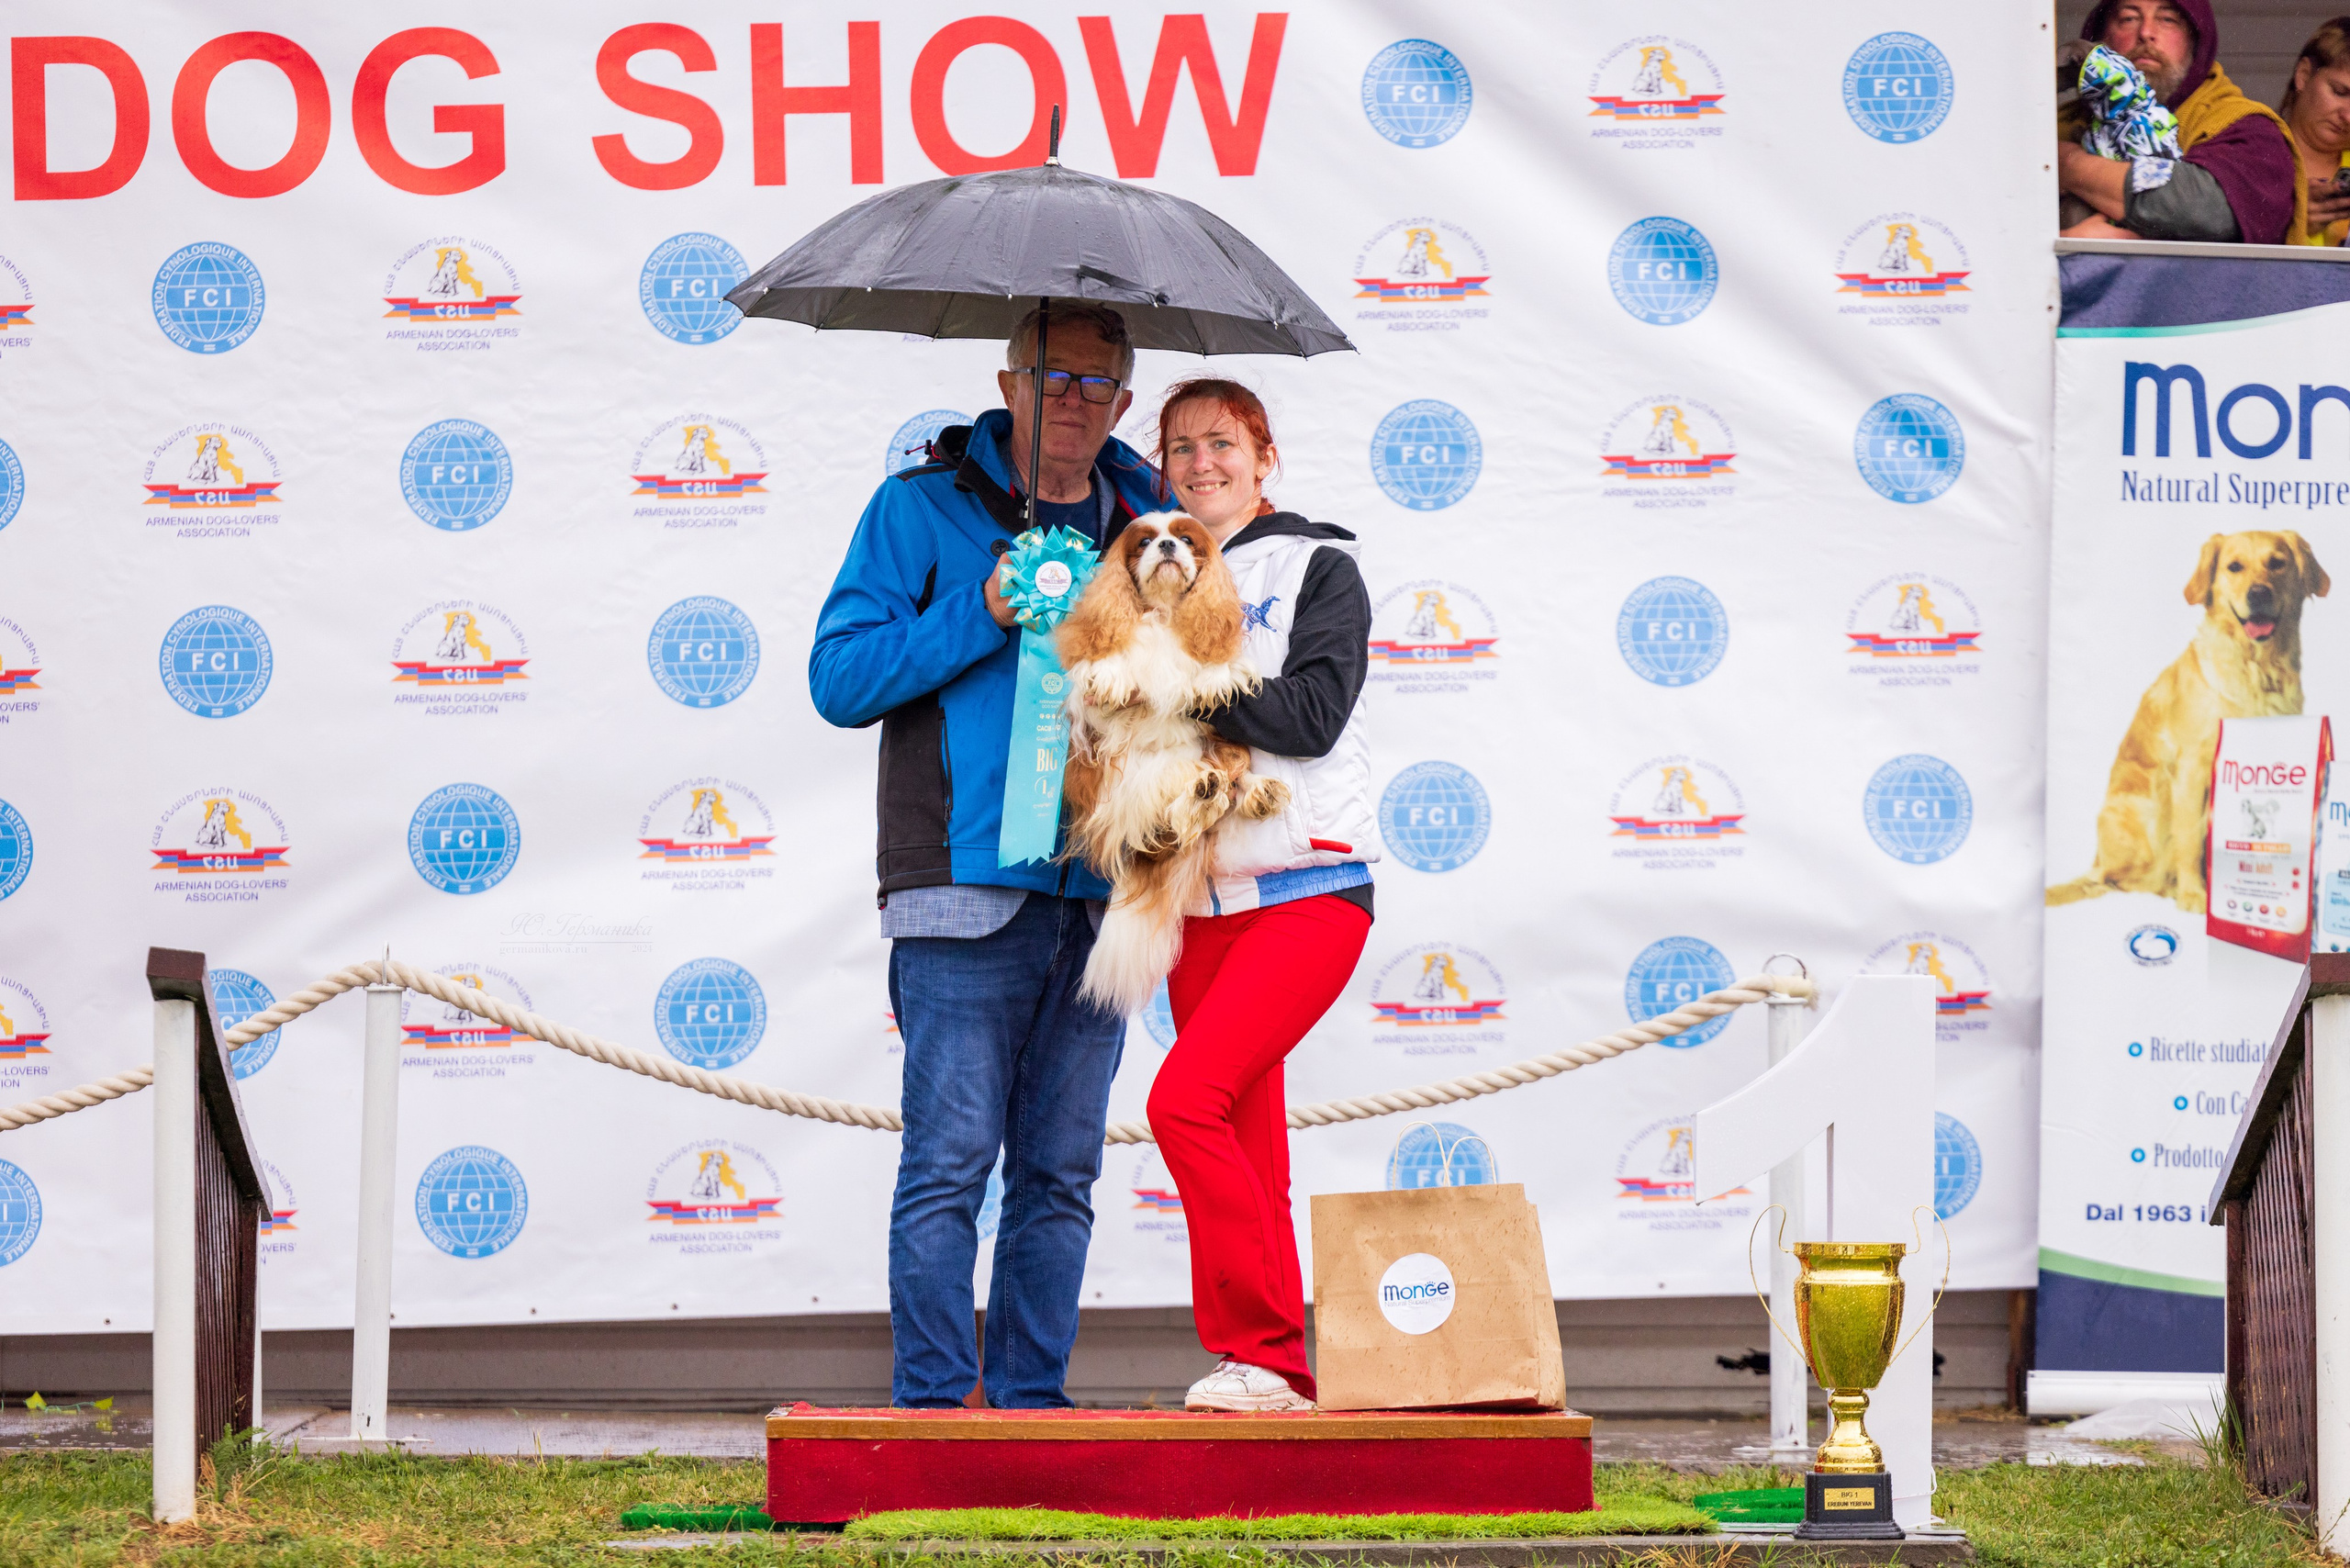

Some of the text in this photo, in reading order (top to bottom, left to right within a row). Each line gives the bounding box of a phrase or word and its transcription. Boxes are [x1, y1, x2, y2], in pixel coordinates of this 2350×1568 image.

[1392, 84, 1438, 102] FCI
[1874, 77, 1920, 96] FCI
[11, 12, 1287, 200] DOG SHOW
[1637, 260, 1684, 278] FCI
[154, 242, 264, 349] FEDERATION CYNOLOGIQUE INTERNATIONALE
[185, 287, 231, 307] FCI
[672, 279, 717, 297] FCI
[386, 330, 442, 340] ARMENIAN
[417, 341, 490, 351] ASSOCIATION
[1403, 445, 1449, 465] FCI
[1886, 439, 1931, 457] FCI
[402, 420, 511, 526] FEDERATION CYNOLOGIQUE INTERNATIONALE
[432, 465, 479, 484] FCI
[2121, 470, 2219, 503] Natural
[145, 517, 203, 527] ARMENIAN
[633, 508, 689, 518] ARMENIAN
[177, 528, 251, 538] ASSOCIATION
[665, 519, 737, 529] ASSOCIATION
[1649, 622, 1695, 641] FCI
[162, 607, 272, 713] FEDERATION CYNOLOGIQUE INTERNATIONALE
[650, 598, 759, 703] FEDERATION CYNOLOGIQUE INTERNATIONALE
[679, 642, 726, 661] FCI
[192, 652, 239, 671] FCI
[394, 694, 451, 704] ARMENIAN
[425, 705, 498, 715] ASSOCIATION
[1036, 747, 1058, 771] BIG
[1411, 807, 1457, 826] FCI
[1895, 800, 1940, 818] FCI
[410, 785, 520, 890] FEDERATION CYNOLOGIQUE INTERNATIONALE
[440, 829, 487, 848] FCI
[641, 870, 697, 880] ARMENIAN
[153, 881, 211, 891] ARMENIAN
[672, 881, 744, 891] ASSOCIATION
[185, 892, 259, 902] ASSOCIATION
[656, 959, 766, 1064] FEDERATION CYNOLOGIQUE INTERNATIONALE
[687, 1004, 733, 1023] FCI
[2150, 1036, 2271, 1062] Ricette studiat
[401, 1057, 458, 1068] ARMENIAN
[432, 1068, 505, 1079] ASSOCIATION
[2196, 1091, 2225, 1114] Con
[2154, 1142, 2224, 1168] Prodotto
[418, 1148, 527, 1254] FEDERATION CYNOLOGIQUE INTERNATIONALE
[448, 1193, 494, 1212] FCI
[2087, 1204, 2122, 1221] Dal
[2133, 1204, 2191, 1222] 1963
[648, 1233, 705, 1243] ARMENIAN
[679, 1243, 753, 1254] ASSOCIATION
[1408, 1295, 1450, 1305] Superpremium
